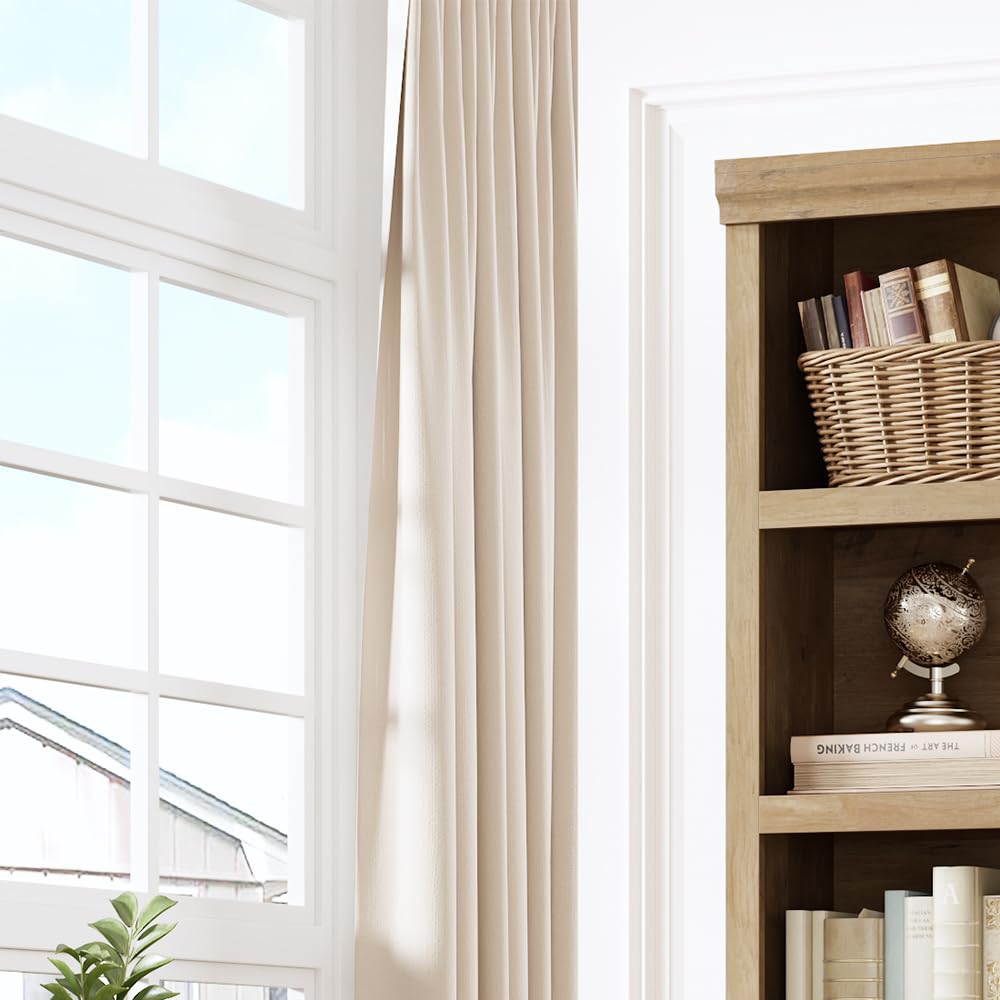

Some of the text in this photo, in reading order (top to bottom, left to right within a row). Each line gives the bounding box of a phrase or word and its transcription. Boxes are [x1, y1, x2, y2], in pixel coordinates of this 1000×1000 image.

[816, 743, 861, 755] BAKING
[863, 742, 906, 753] FRENCH
[921, 742, 939, 751] ART
[942, 741, 960, 751] THE
